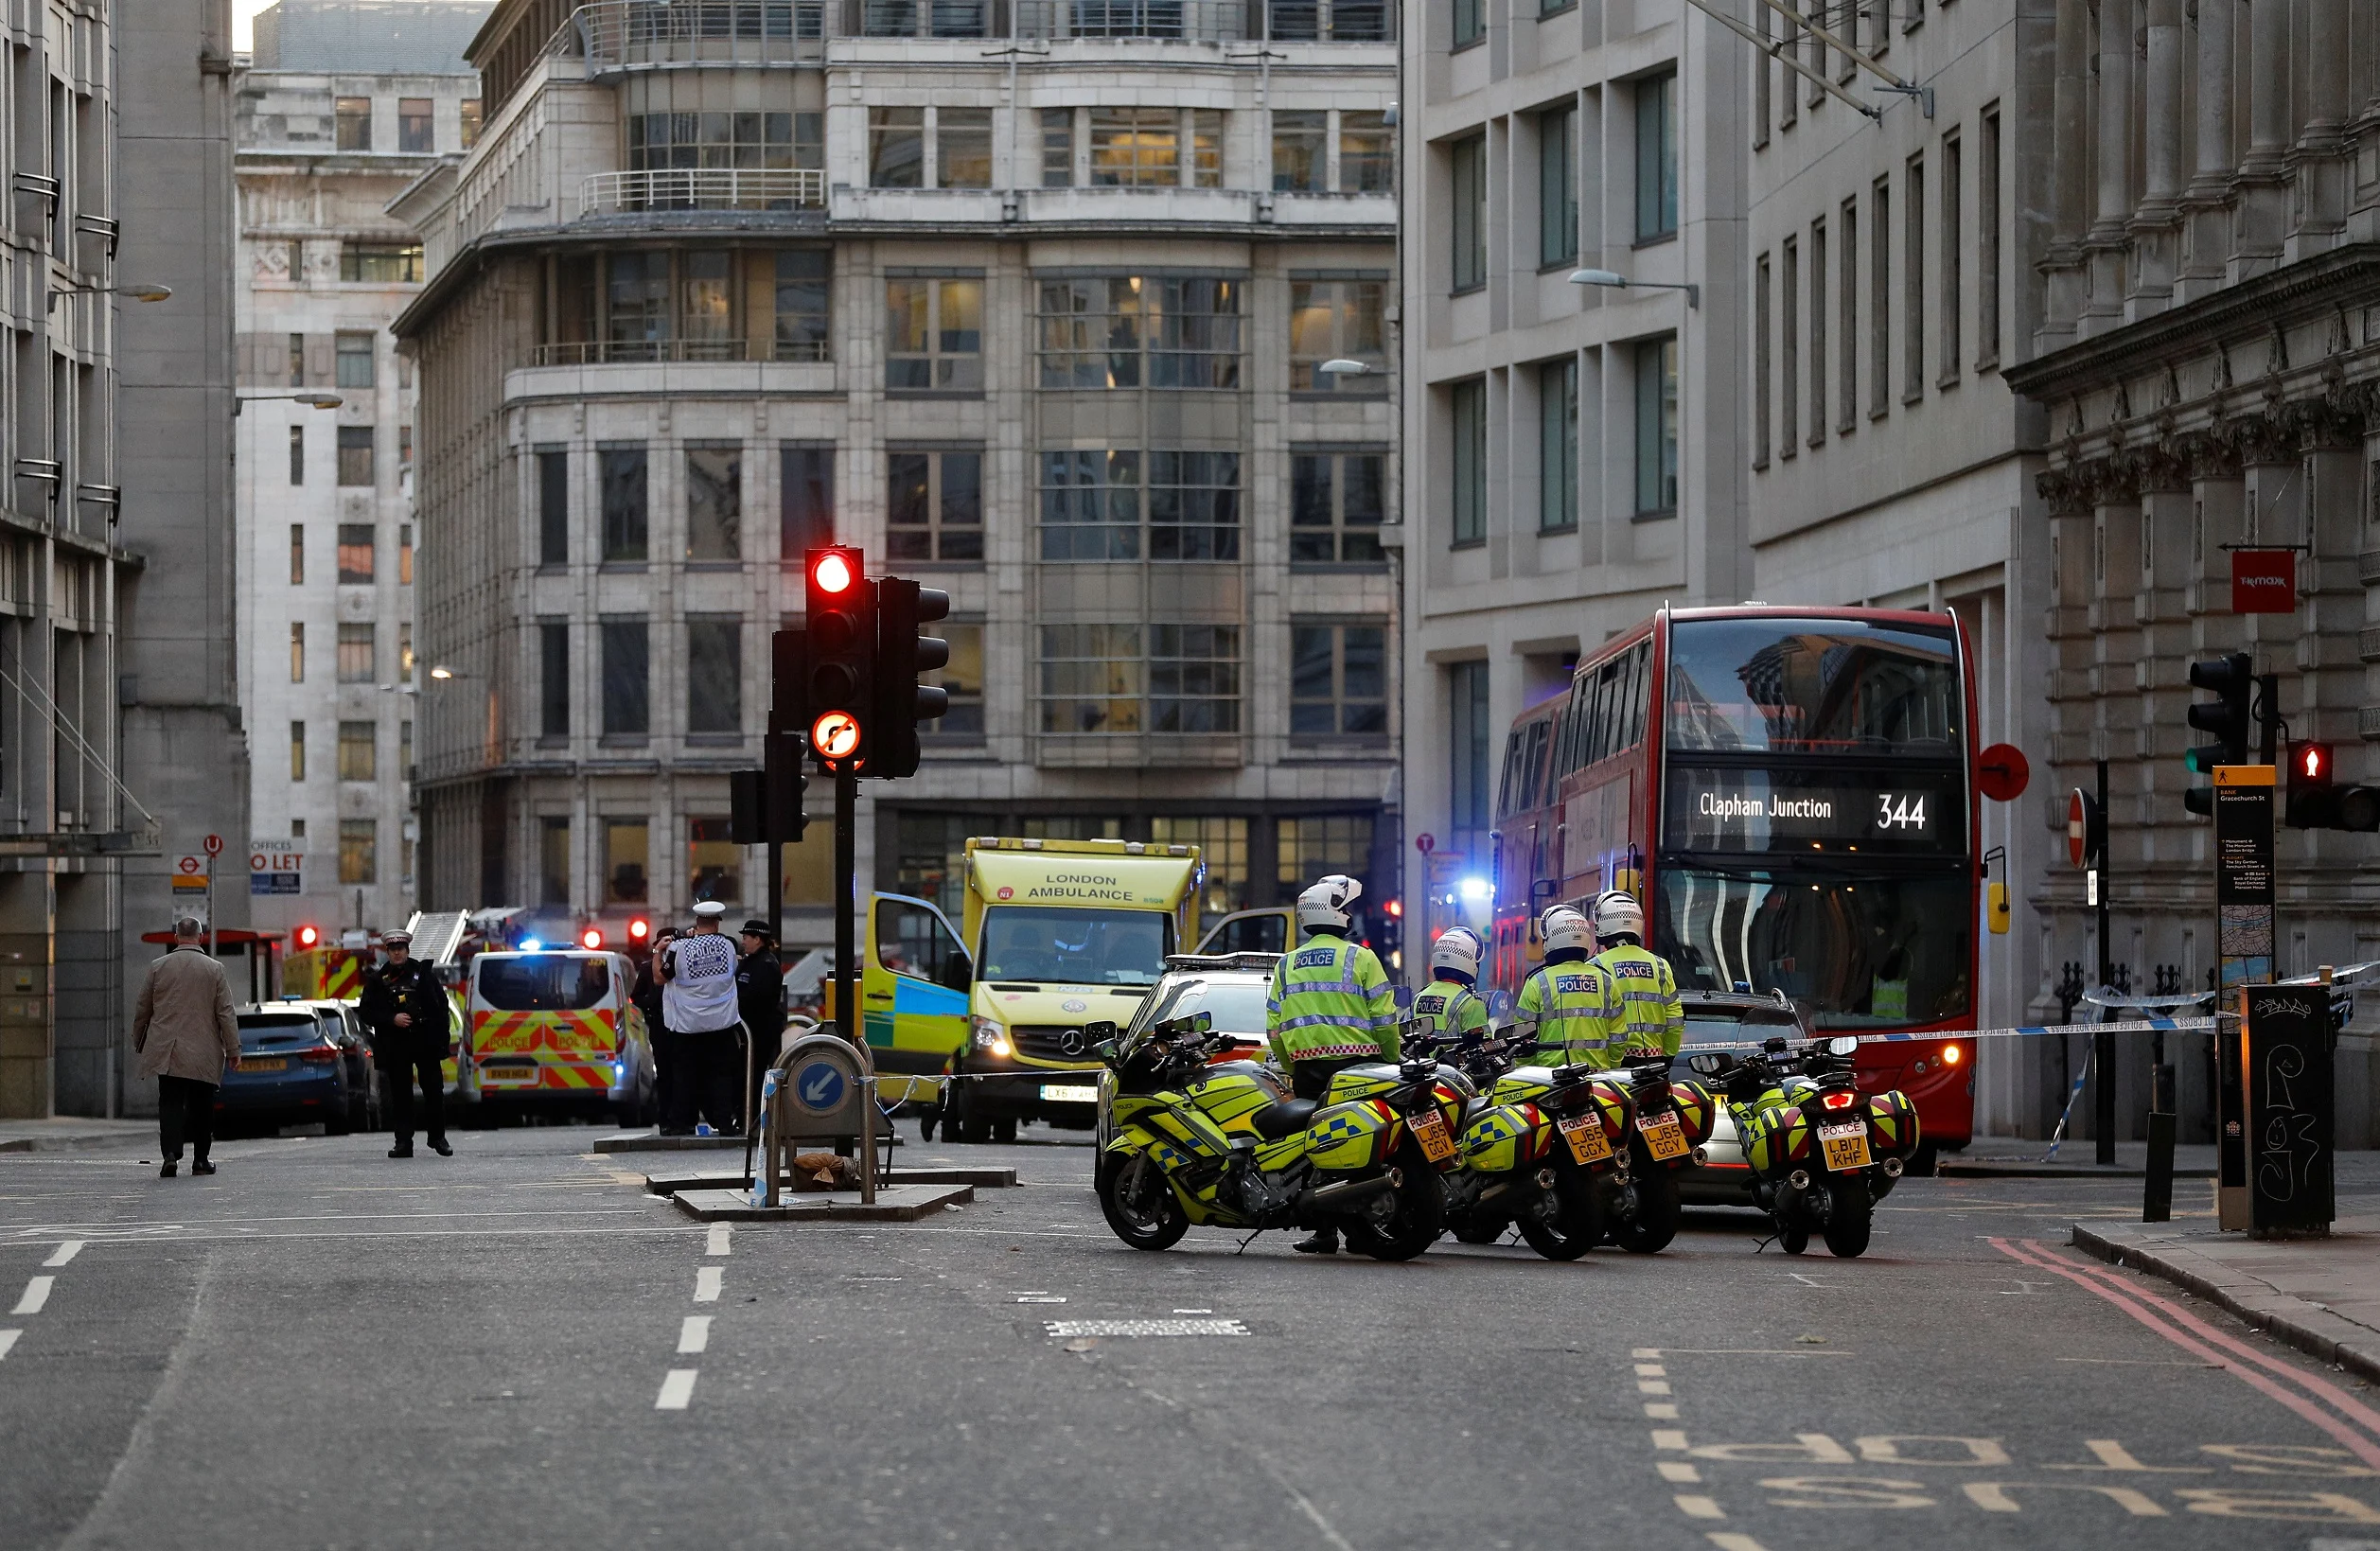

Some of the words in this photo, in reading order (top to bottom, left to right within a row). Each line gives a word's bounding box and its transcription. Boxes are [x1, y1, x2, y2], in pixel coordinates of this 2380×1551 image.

[1700, 793, 1763, 821] Clapham
[1769, 794, 1831, 819] Junction
[1877, 794, 1926, 830] 344
[251, 840, 291, 851] OFFICES
[273, 854, 304, 871] LET
[1047, 874, 1117, 886] LONDON
[1028, 888, 1133, 901] AMBULANCE
[691, 945, 720, 958] POLICE
[1296, 954, 1332, 968] POLICE
[1615, 966, 1652, 977] POLICE
[1559, 981, 1596, 992] POLICE
[1417, 1001, 1443, 1013] POLICE
[2120, 1021, 2143, 1030] POLICE
[2179, 1017, 2202, 1027] CROSS
[488, 1036, 531, 1049] POLICE
[557, 1036, 600, 1049] POLICE
[1343, 1087, 1369, 1098] POLICE
[1502, 1091, 1524, 1102] POLICE
[1410, 1111, 1439, 1128] POLICE
[1561, 1114, 1597, 1131] POLICE
[1639, 1113, 1676, 1129] POLICE
[1418, 1123, 1447, 1143] LJ65
[1568, 1127, 1604, 1146] LJ65
[1646, 1125, 1681, 1144] LJ65
[1823, 1123, 1861, 1137] POLICE
[1427, 1137, 1450, 1155] GGV
[1578, 1141, 1607, 1159] GGX
[1656, 1138, 1683, 1155] GGY
[1828, 1137, 1862, 1154] LB17
[1833, 1151, 1862, 1166] KHF
